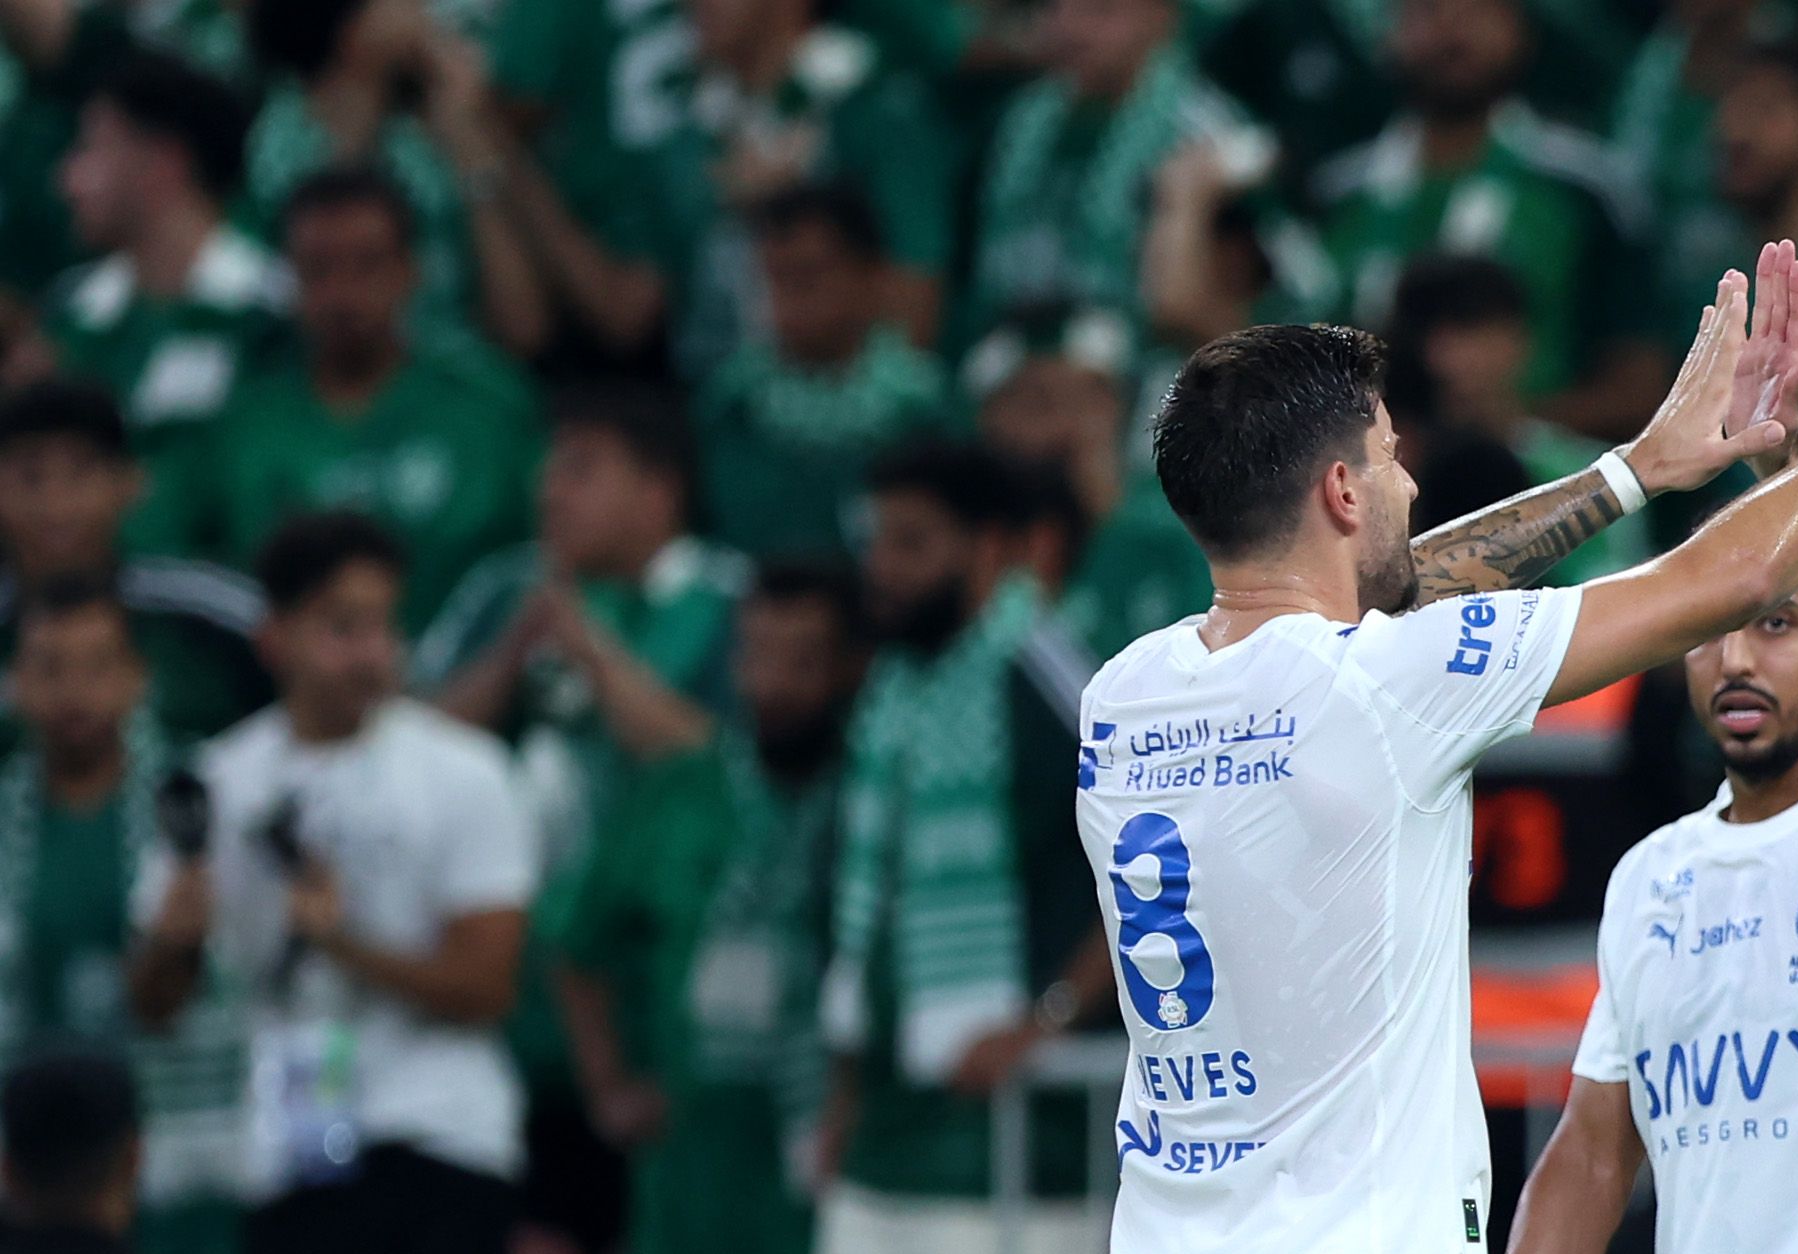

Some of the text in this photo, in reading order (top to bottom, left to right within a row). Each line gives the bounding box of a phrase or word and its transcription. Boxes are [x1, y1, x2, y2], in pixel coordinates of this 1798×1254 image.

[1446, 592, 1497, 677] tre
[1213, 751, 1294, 787] Bank
[1108, 812, 1215, 1032] 8
[1137, 1050, 1258, 1102] EVES
[1163, 1141, 1268, 1175] SEVE
